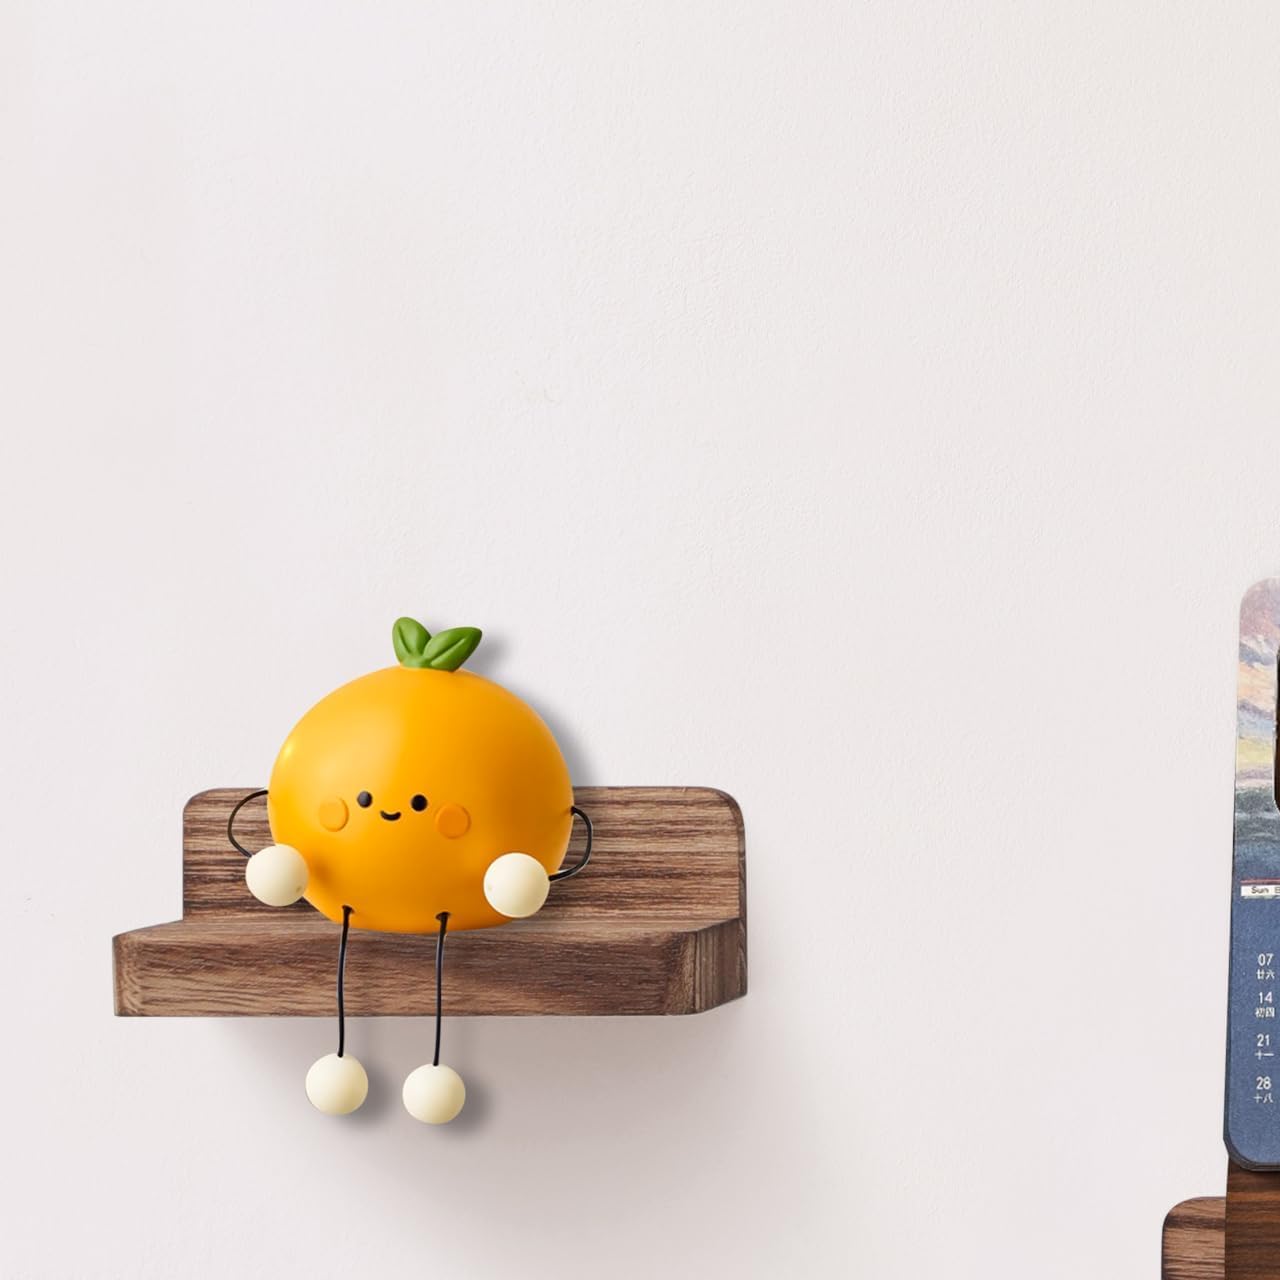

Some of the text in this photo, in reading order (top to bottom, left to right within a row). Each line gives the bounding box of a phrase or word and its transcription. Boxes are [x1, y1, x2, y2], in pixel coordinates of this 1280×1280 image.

[1251, 886, 1269, 894] Sun
[1257, 953, 1274, 966] 07
[1256, 969, 1275, 980] 廿六
[1259, 991, 1272, 1003] 14
[1257, 1034, 1270, 1046] 21
[1255, 1050, 1274, 1060] 十一
[1256, 1076, 1272, 1090] 28
[1254, 1093, 1273, 1103] 十八
